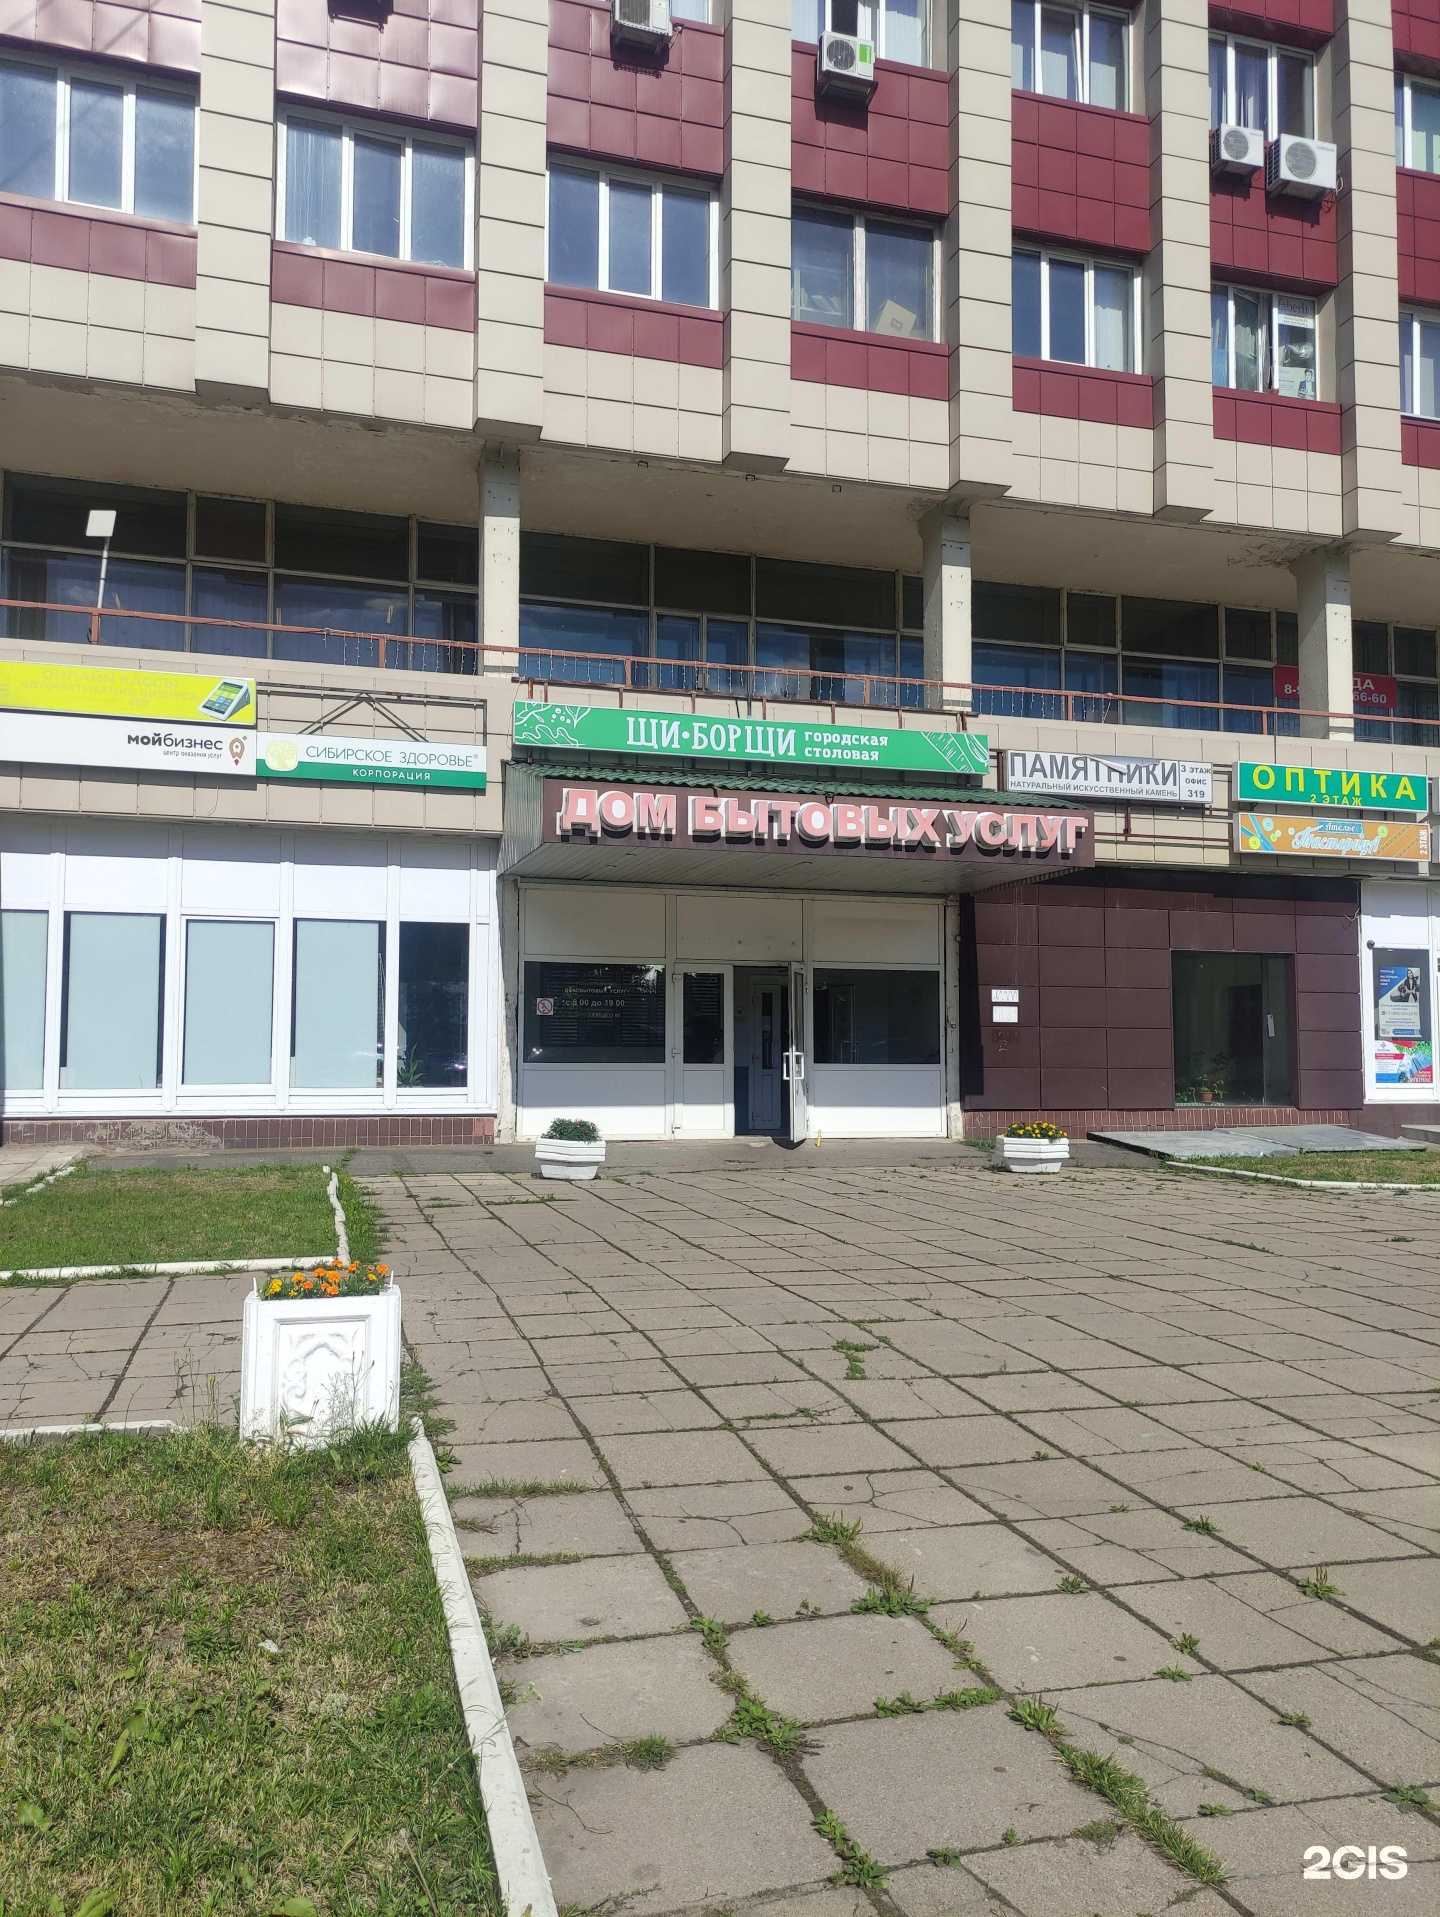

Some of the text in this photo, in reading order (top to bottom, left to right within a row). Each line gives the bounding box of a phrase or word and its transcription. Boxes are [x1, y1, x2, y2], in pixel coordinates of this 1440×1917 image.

[804, 730, 889, 747] городская
[306, 745, 392, 763] СИБИРСКОЕ
[804, 745, 880, 761] столовая
[352, 768, 431, 781] КОРПОРАЦИЯ
[1010, 752, 1178, 787] ПАМЯТНИКИ
[1180, 764, 1187, 773] 3
[1010, 780, 1178, 798] НАТУРАЛЬНЫЙ ИСКУССТВЕННЫЙ КАМЕНЬ
[1252, 764, 1416, 801] ОПТИКА
[1187, 789, 1205, 799] 319
[1310, 793, 1363, 807] 2 ЭТАЖ
[556, 787, 1089, 854] ДОМ БЫТОВЫХ УСЛУГ
